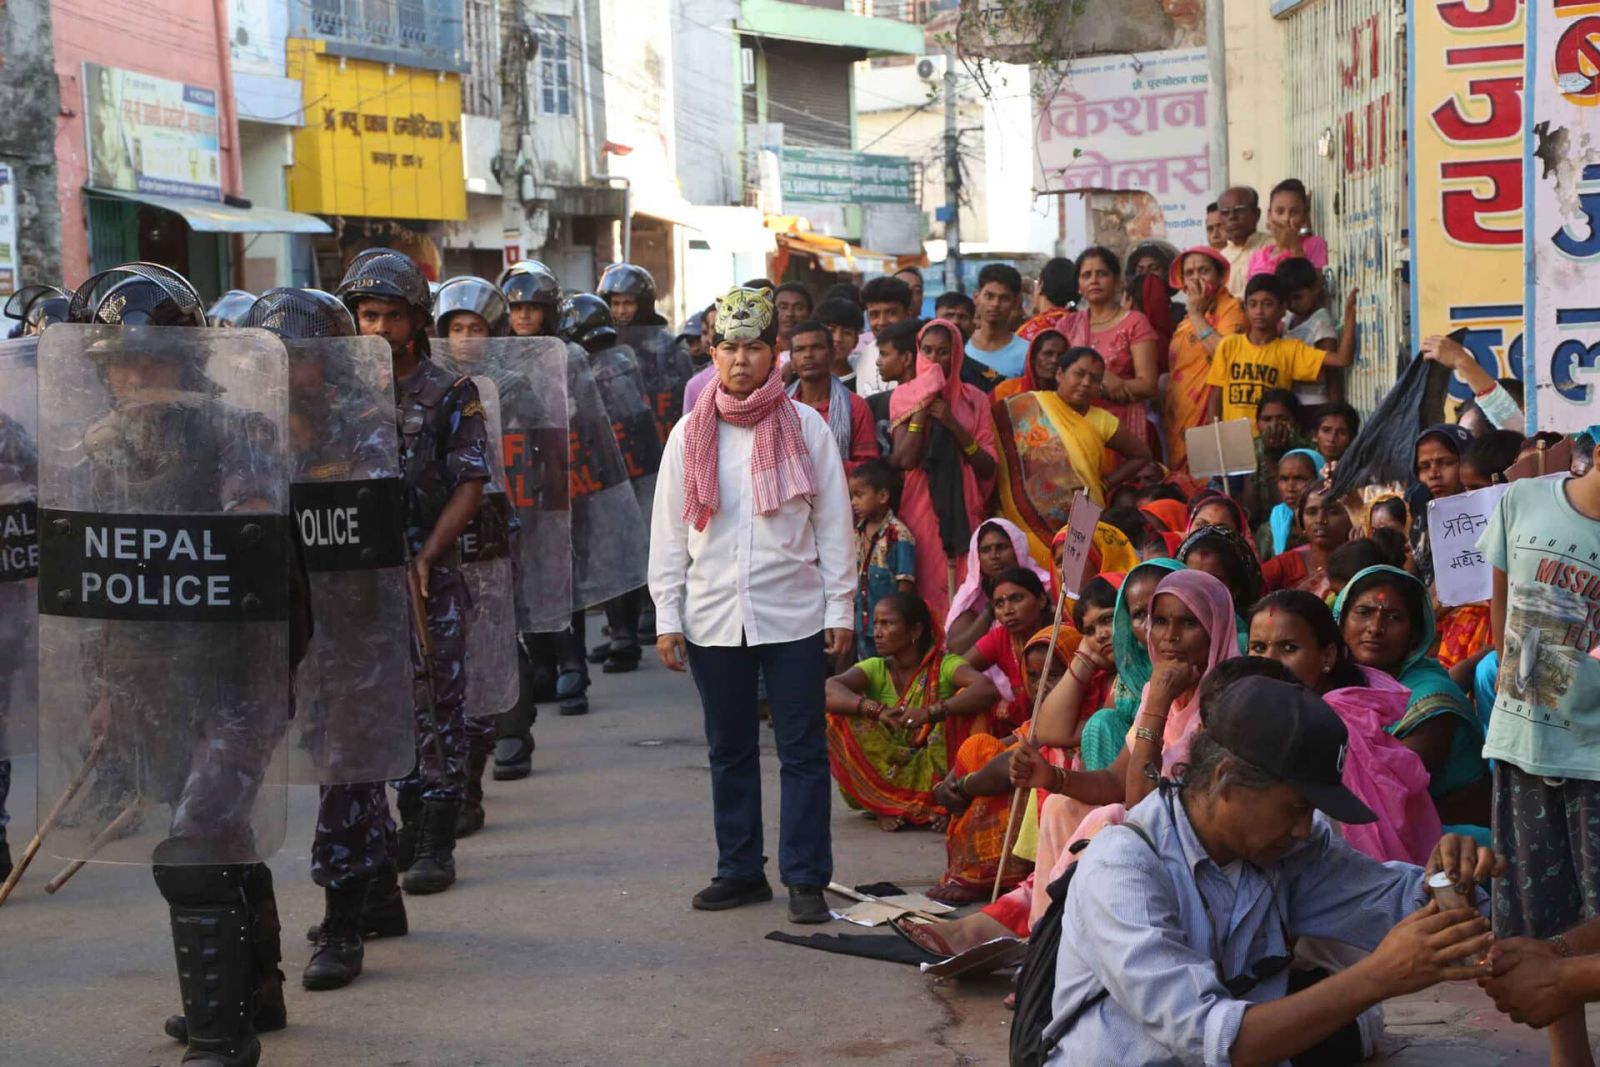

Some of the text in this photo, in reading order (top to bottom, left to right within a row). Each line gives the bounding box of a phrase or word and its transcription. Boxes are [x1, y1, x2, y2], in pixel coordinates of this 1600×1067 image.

[1040, 89, 1209, 142] किशन
[0, 512, 36, 539] AL
[297, 506, 361, 547] OLICE
[0, 543, 40, 572] ICE
[84, 526, 228, 561] NEPAL
[80, 571, 232, 606] POLICE
